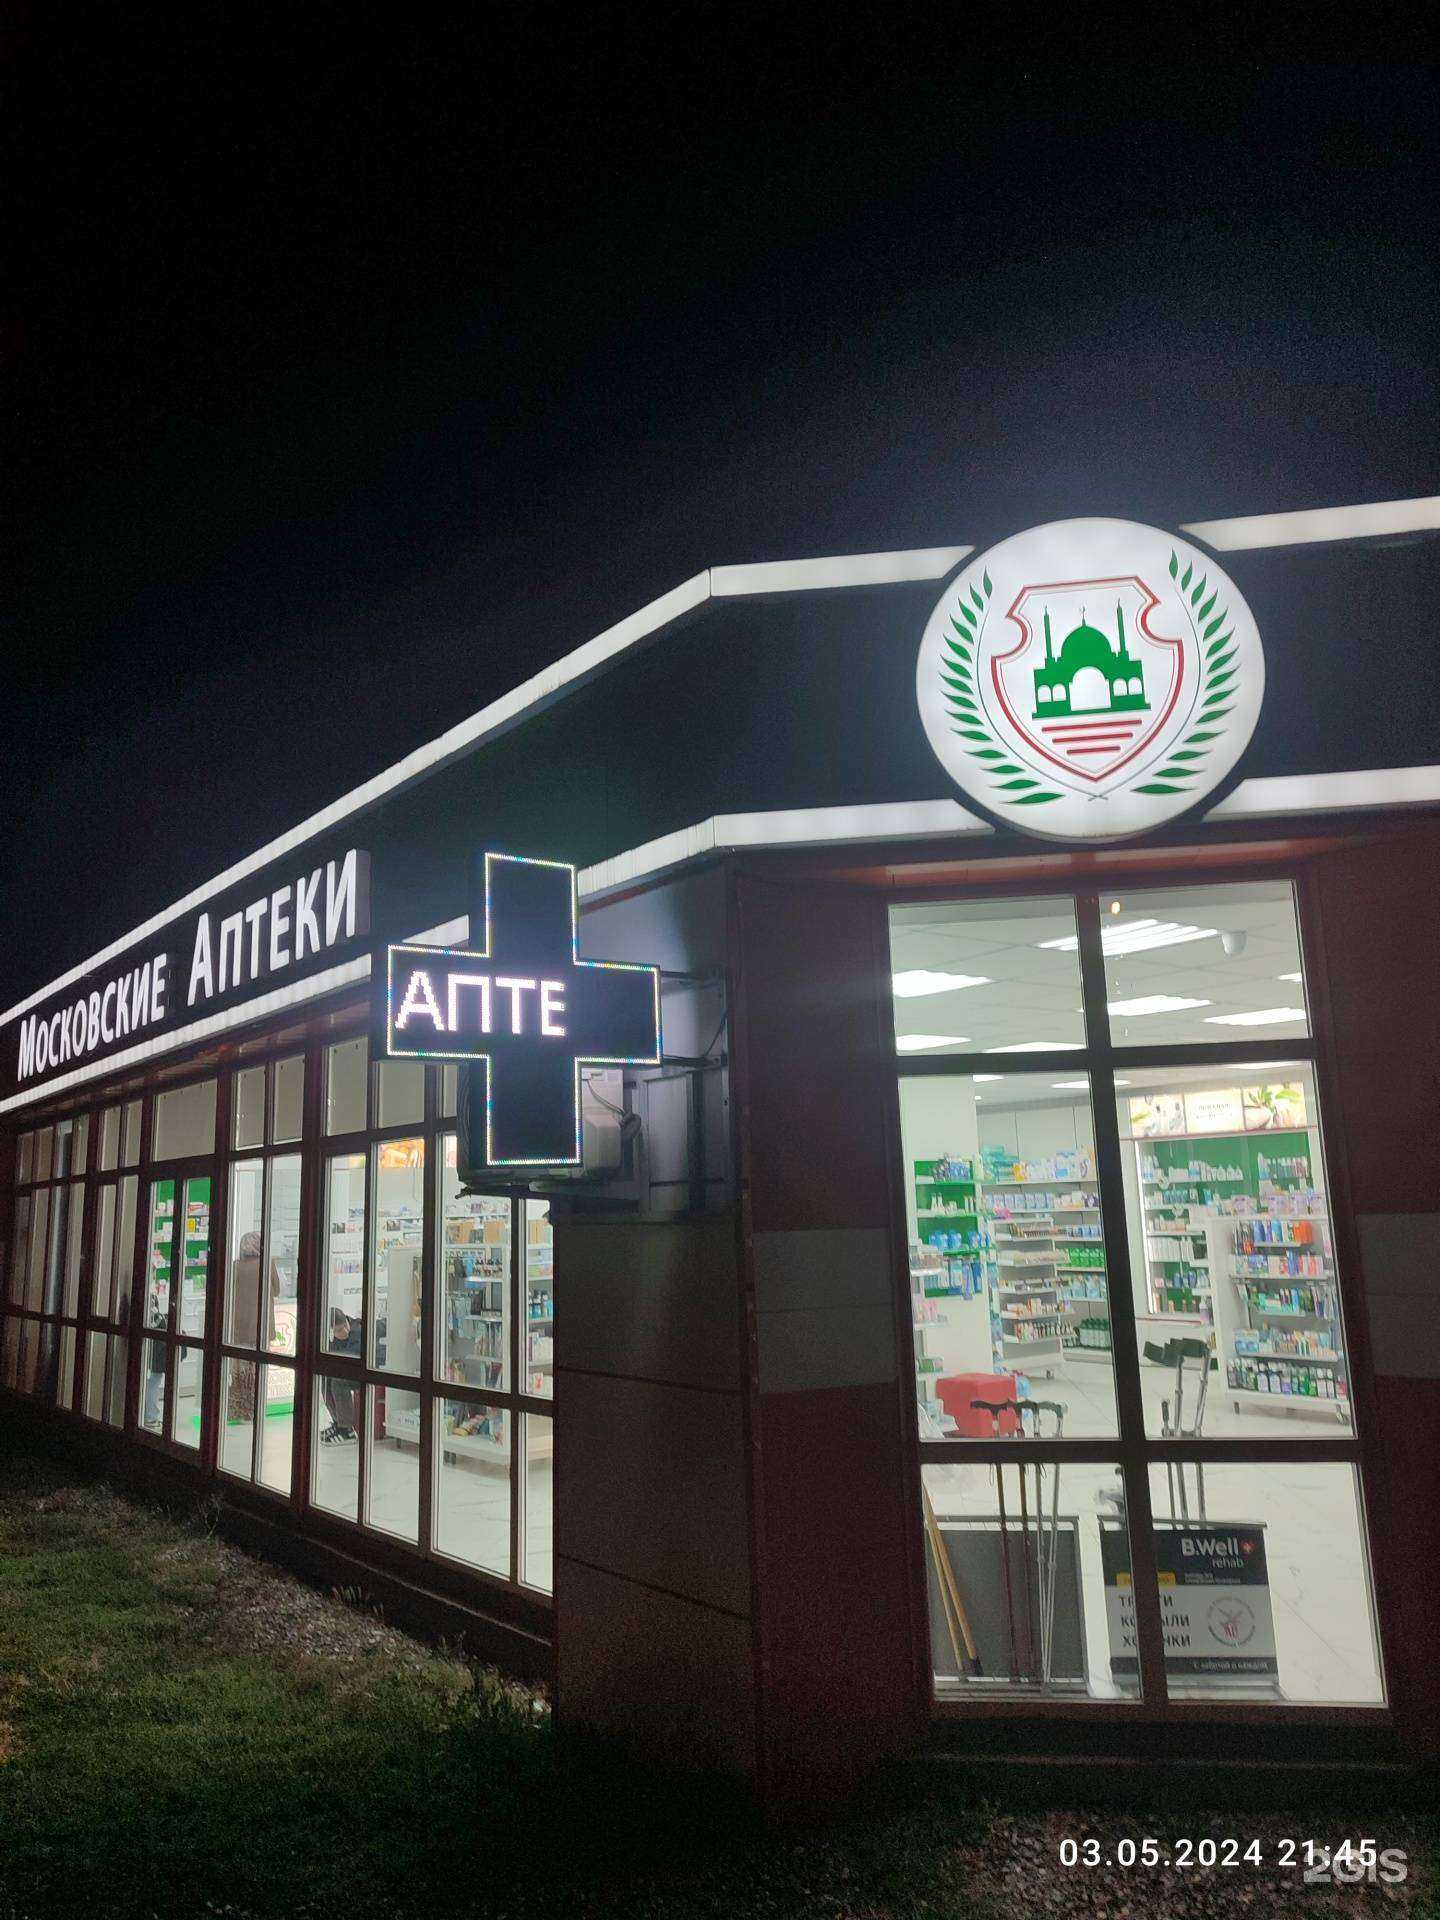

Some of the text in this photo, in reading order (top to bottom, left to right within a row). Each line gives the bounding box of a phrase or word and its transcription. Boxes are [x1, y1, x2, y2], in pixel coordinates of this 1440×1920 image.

[17, 849, 357, 1081] МОСКОВСКИЕ АПТЕКИ
[394, 970, 567, 1037] АПТЕ
[1181, 1536, 1239, 1556] B.Well
[1211, 1555, 1245, 1569] rehab
